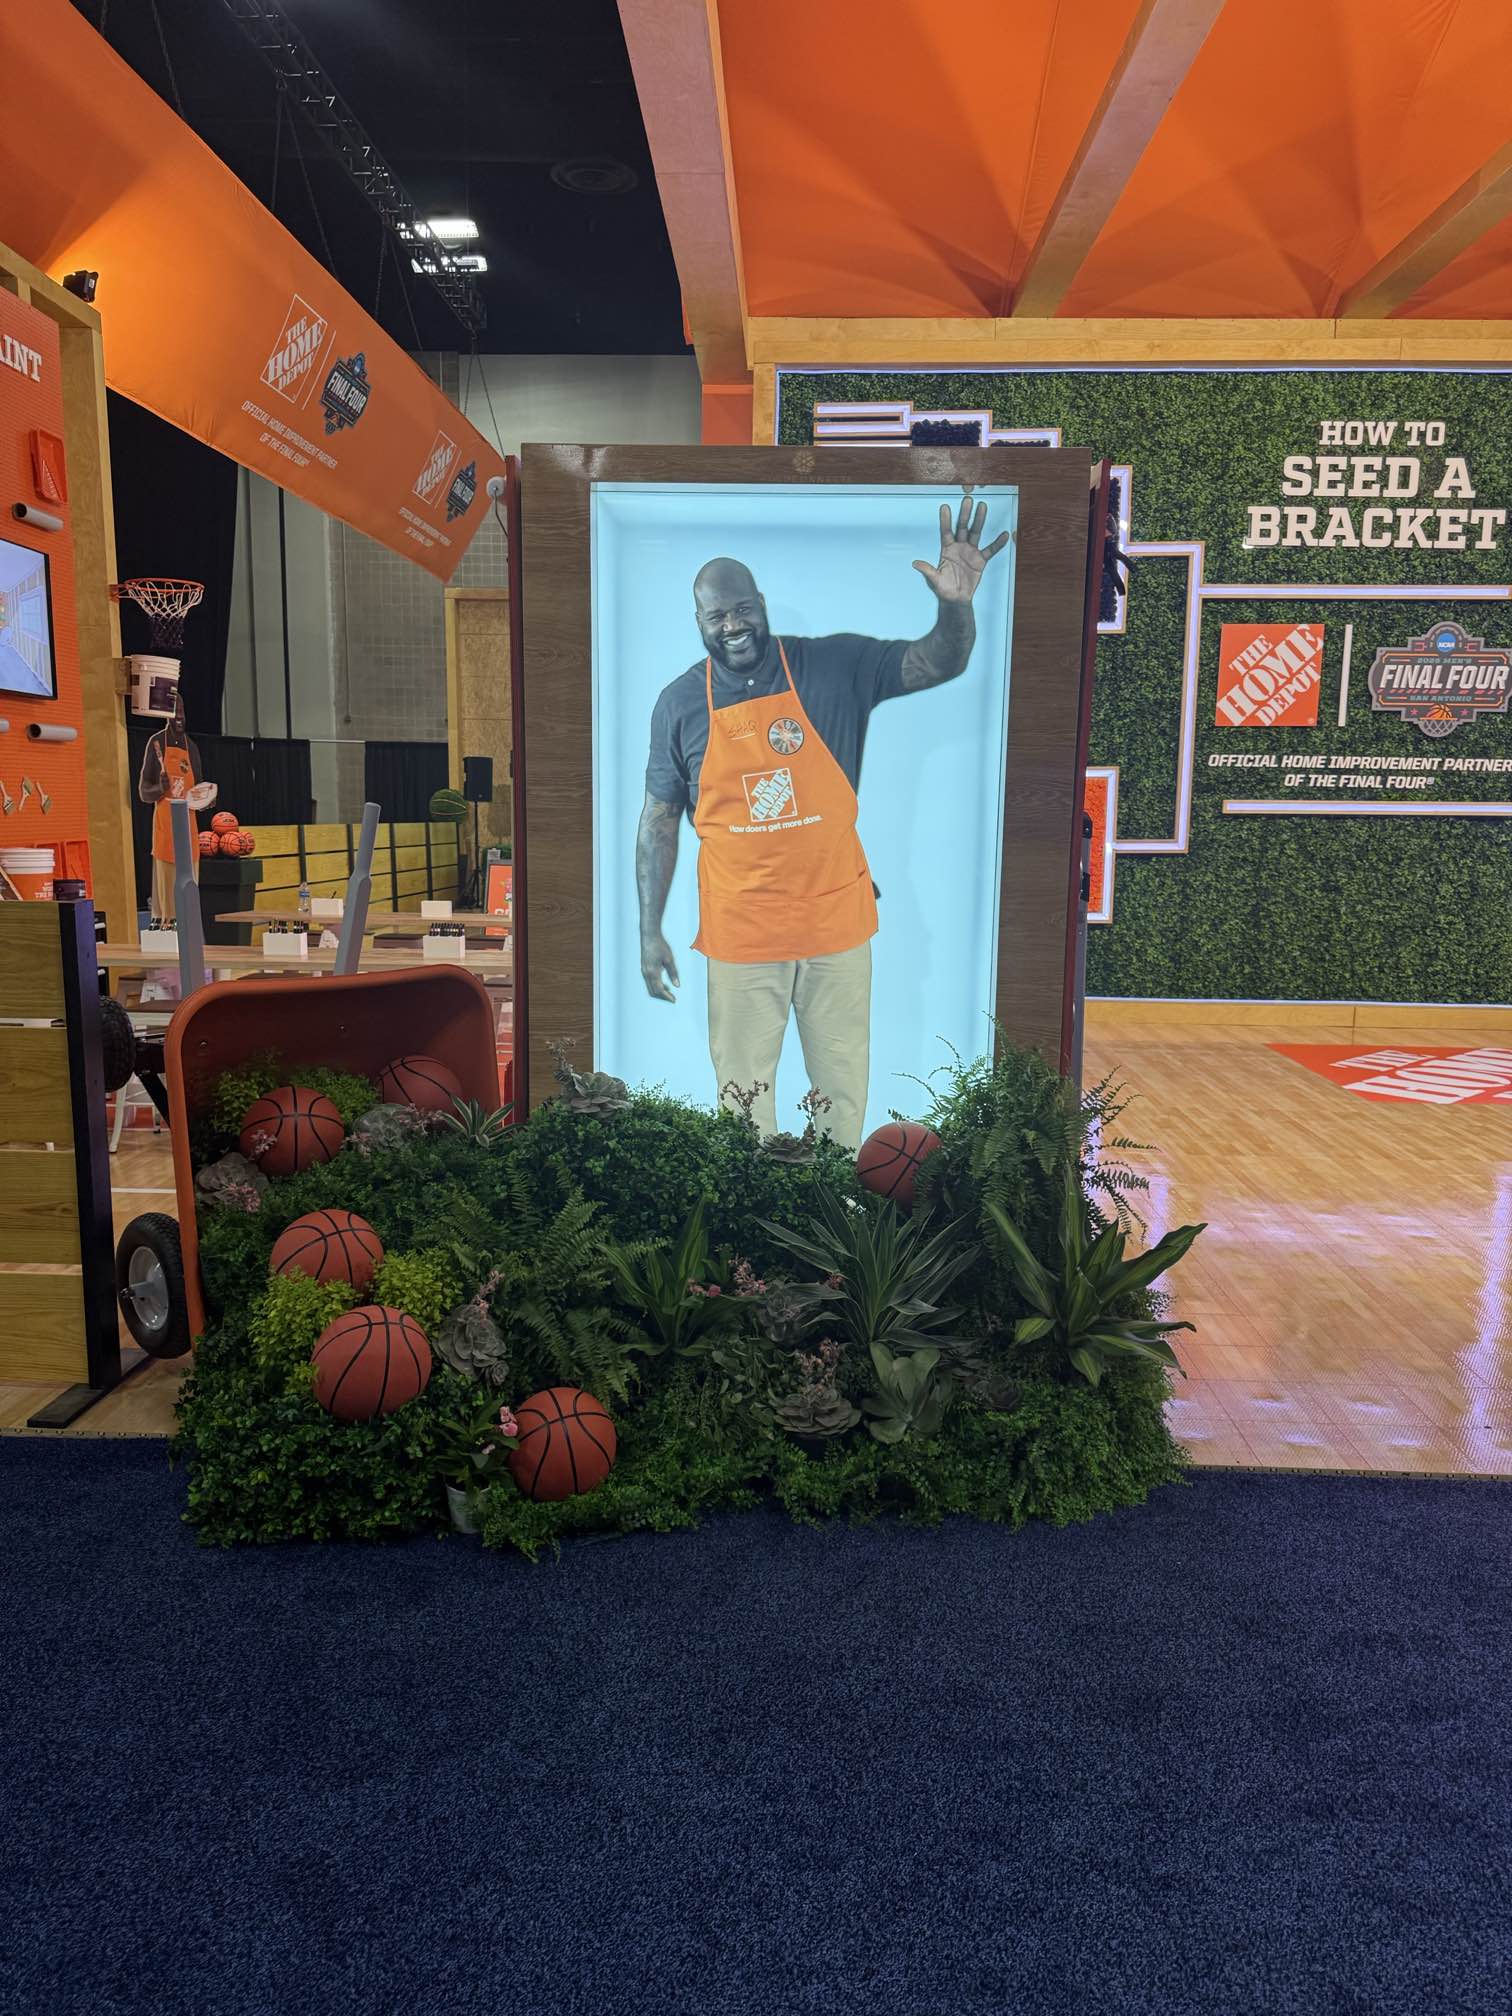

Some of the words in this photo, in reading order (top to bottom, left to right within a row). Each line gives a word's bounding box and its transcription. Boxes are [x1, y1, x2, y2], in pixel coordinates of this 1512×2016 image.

[286, 316, 308, 344] THE
[267, 319, 324, 384] HOME
[278, 350, 314, 391] DEPOT
[241, 400, 269, 425] OFFICIAL
[327, 371, 347, 402] FINAL
[345, 388, 368, 414] FOUR
[1319, 420, 1398, 446] HOW
[1404, 421, 1446, 447] TO
[1281, 455, 1421, 498] SEED
[1434, 457, 1476, 499] A
[1246, 506, 1507, 550] BRACKET
[1216, 624, 1324, 726] HOME
[1229, 634, 1273, 676] THE
[1255, 662, 1321, 726] DEPOT
[1380, 664, 1443, 689] FINAL
[1445, 665, 1510, 690] FOUR
[1208, 754, 1278, 768] OFFICIAL
[1281, 755, 1326, 769] HOME
[1328, 755, 1441, 770] IMPROVEMENT
[1443, 757, 1512, 772] PARTNER
[1284, 774, 1305, 787] OF
[1307, 774, 1337, 788] THE
[1338, 775, 1383, 788] FINAL
[751, 769, 791, 819] HOME
[745, 824, 767, 833] doers
[767, 822, 782, 832] get
[782, 819, 802, 829] more
